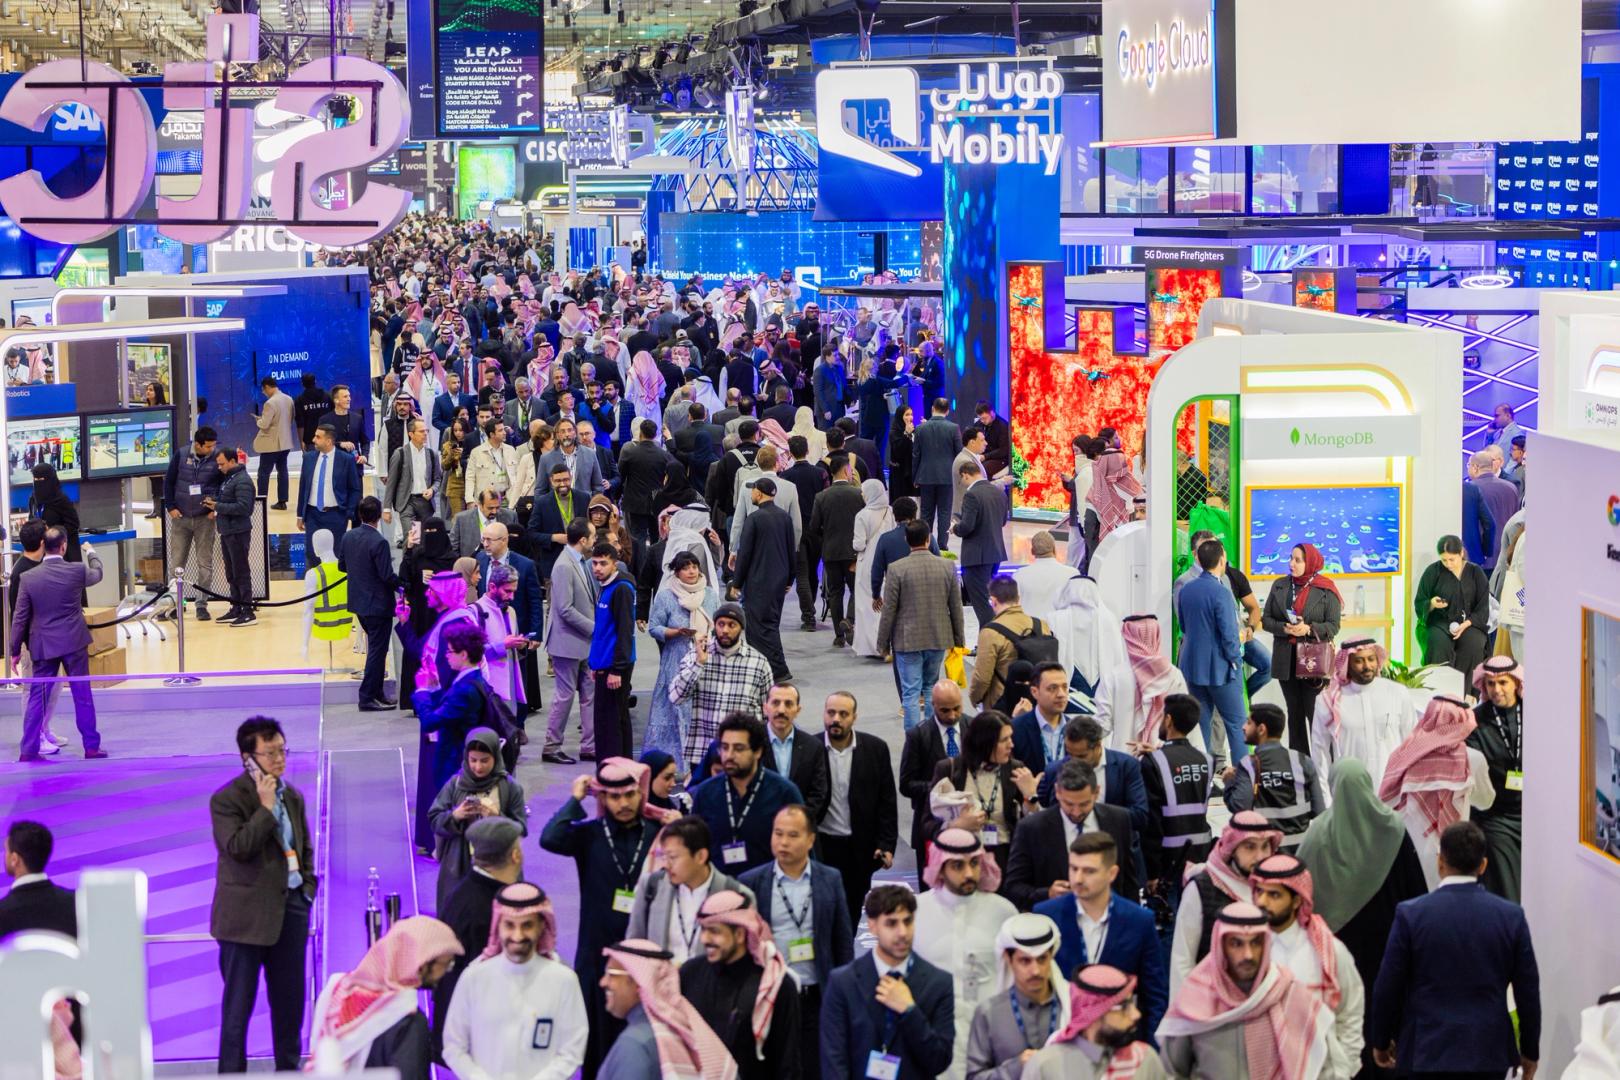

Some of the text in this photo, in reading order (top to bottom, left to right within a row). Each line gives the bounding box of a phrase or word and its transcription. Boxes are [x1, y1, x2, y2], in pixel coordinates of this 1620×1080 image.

[465, 46, 511, 57] LEAP
[1117, 15, 1209, 89] Google Cloud
[930, 62, 1064, 121] موبايلي
[174, 132, 204, 141] Takamol
[931, 119, 1063, 175] Mobily
[1144, 250, 1224, 262] 5G Drone Firefighters
[206, 303, 223, 317] SAP
[280, 352, 309, 363] DEMAND
[1304, 431, 1373, 448] MongoDB
[1181, 764, 1208, 774] REC
[1174, 774, 1201, 785] ORD
